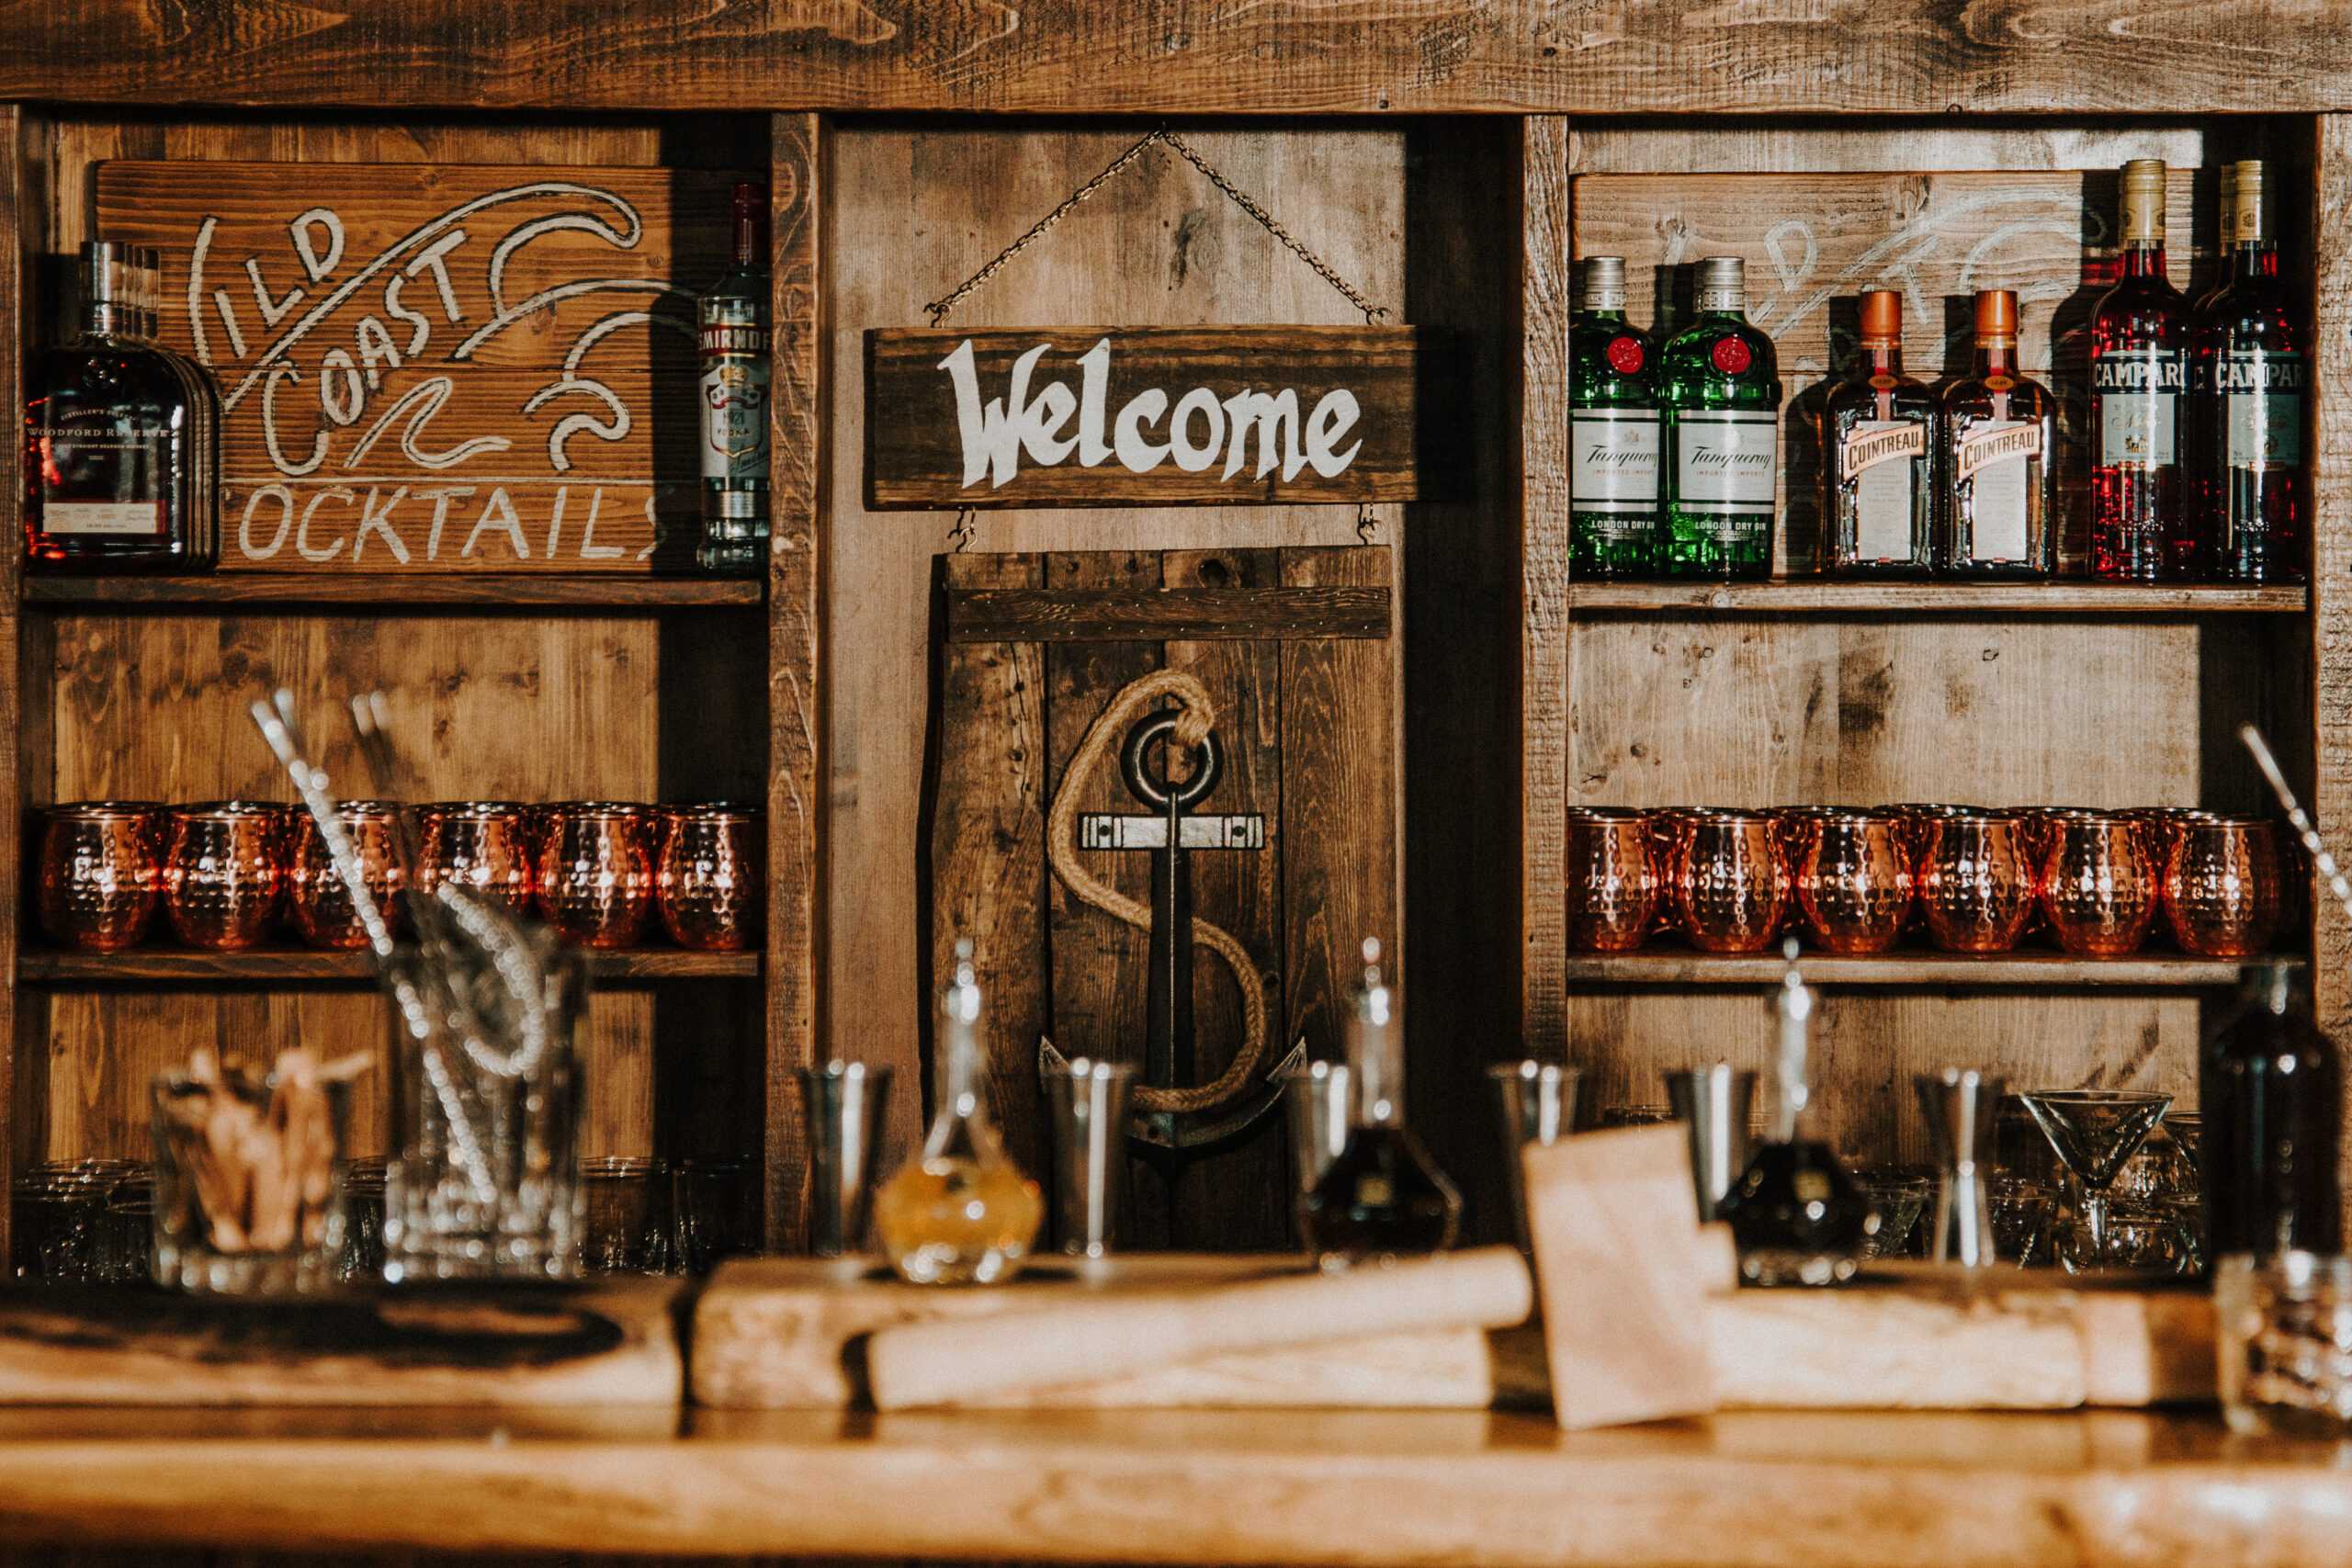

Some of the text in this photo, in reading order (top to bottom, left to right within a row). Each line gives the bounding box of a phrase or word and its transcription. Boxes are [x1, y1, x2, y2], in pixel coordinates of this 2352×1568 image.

[263, 230, 469, 475] COAST
[2095, 362, 2185, 387] CAMPARI
[937, 337, 1363, 491] Welcome
[27, 427, 101, 438] WOODFORD
[1690, 446, 1771, 469] Tanqueray
[1848, 430, 1919, 471] COINTREAU
[1963, 430, 2035, 471] COINTREAU
[226, 484, 676, 565] OCKTAILS
[1590, 519, 1629, 530] LONDON
[1631, 520, 1645, 530] DRY
[1695, 521, 1767, 531] LONDON DRY GIN
